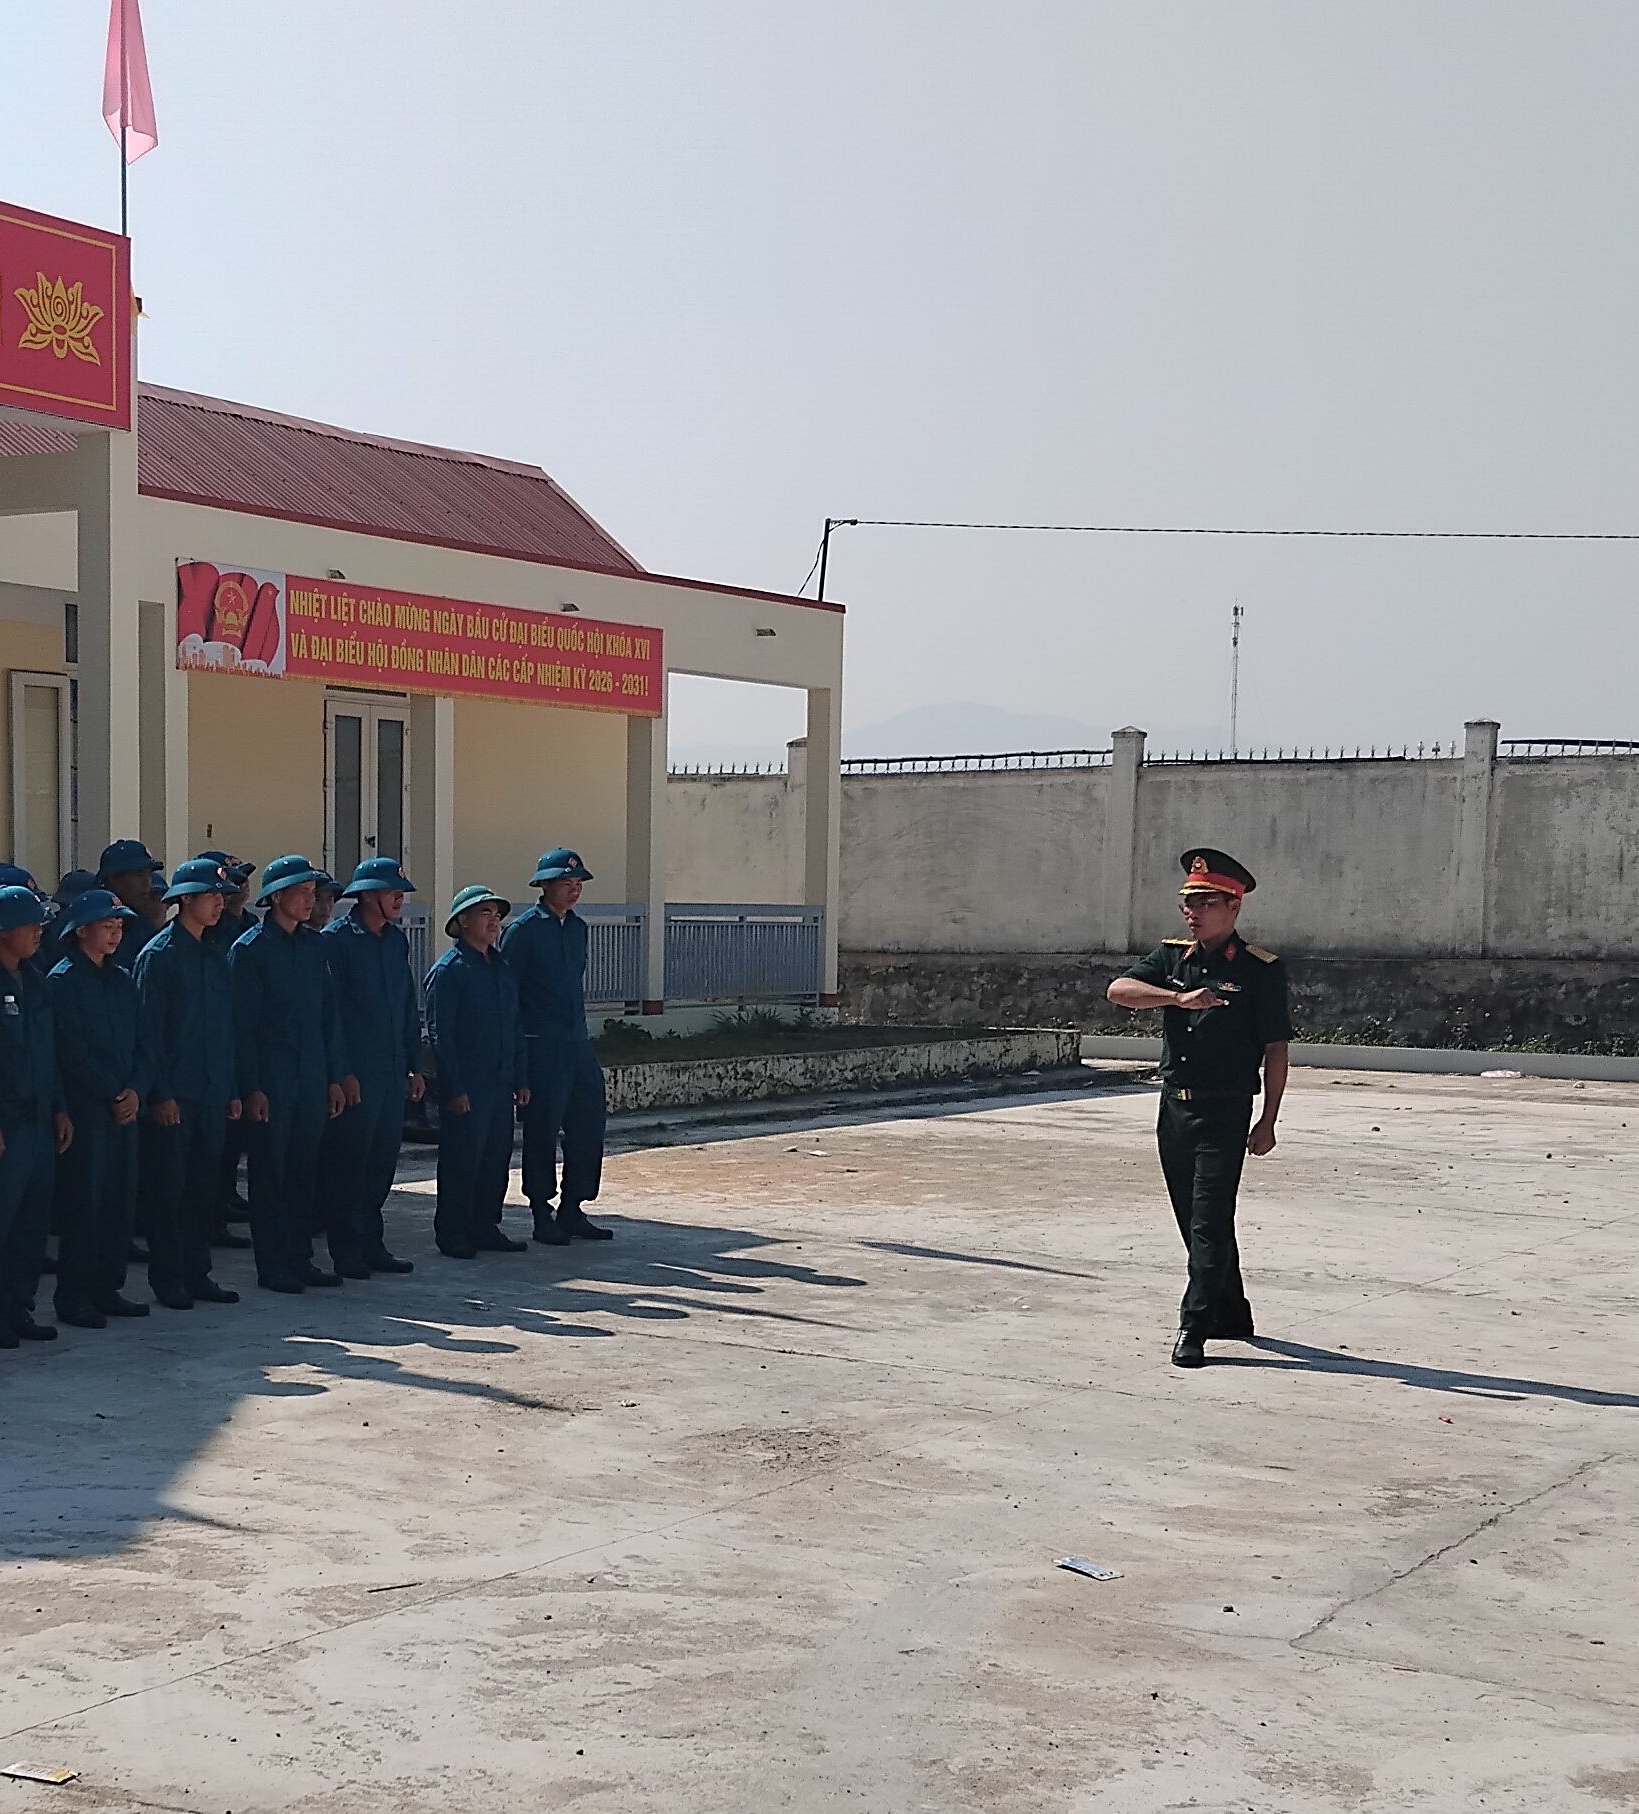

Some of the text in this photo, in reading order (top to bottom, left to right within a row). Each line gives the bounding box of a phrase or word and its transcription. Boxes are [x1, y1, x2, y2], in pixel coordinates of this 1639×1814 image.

[290, 588, 650, 660] NHIỆT LIỆT CHÀO MỪNG NGÀY BẦU CỬ ĐẠI BIỂU QUỐC HỘI KHÓA XVI
[291, 629, 308, 658] VÀ
[311, 635, 332, 666] ĐẠI
[336, 631, 364, 665] BIỂU
[368, 638, 388, 673] HỘI
[391, 639, 423, 672] ĐỒNG
[427, 647, 459, 676] NHÂN
[462, 650, 485, 679] DÂN
[488, 653, 510, 681] CÁC
[513, 654, 534, 684] CẤP
[537, 661, 570, 691] NHIỆM
[573, 664, 587, 690] KỲ
[589, 669, 612, 692] 2026
[622, 674, 649, 696] 2031!
